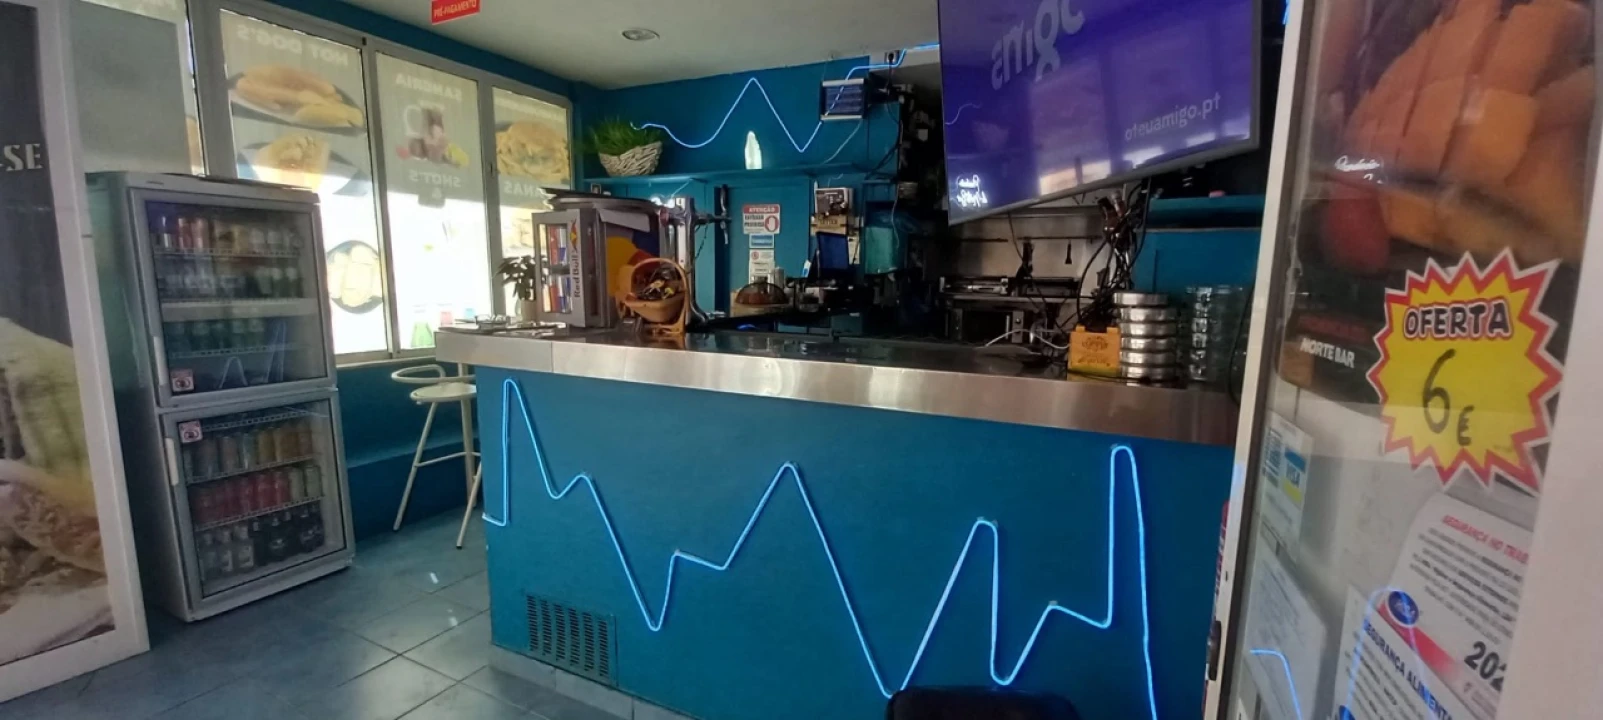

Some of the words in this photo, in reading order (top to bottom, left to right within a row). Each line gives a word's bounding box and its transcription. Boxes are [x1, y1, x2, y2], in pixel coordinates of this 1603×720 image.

[1125, 92, 1221, 142] oteuamigo.pt
[571, 255, 580, 278] Bull
[1404, 300, 1513, 338] OFERTA
[1300, 337, 1335, 361] NORTE
[1334, 347, 1355, 368] BAR
